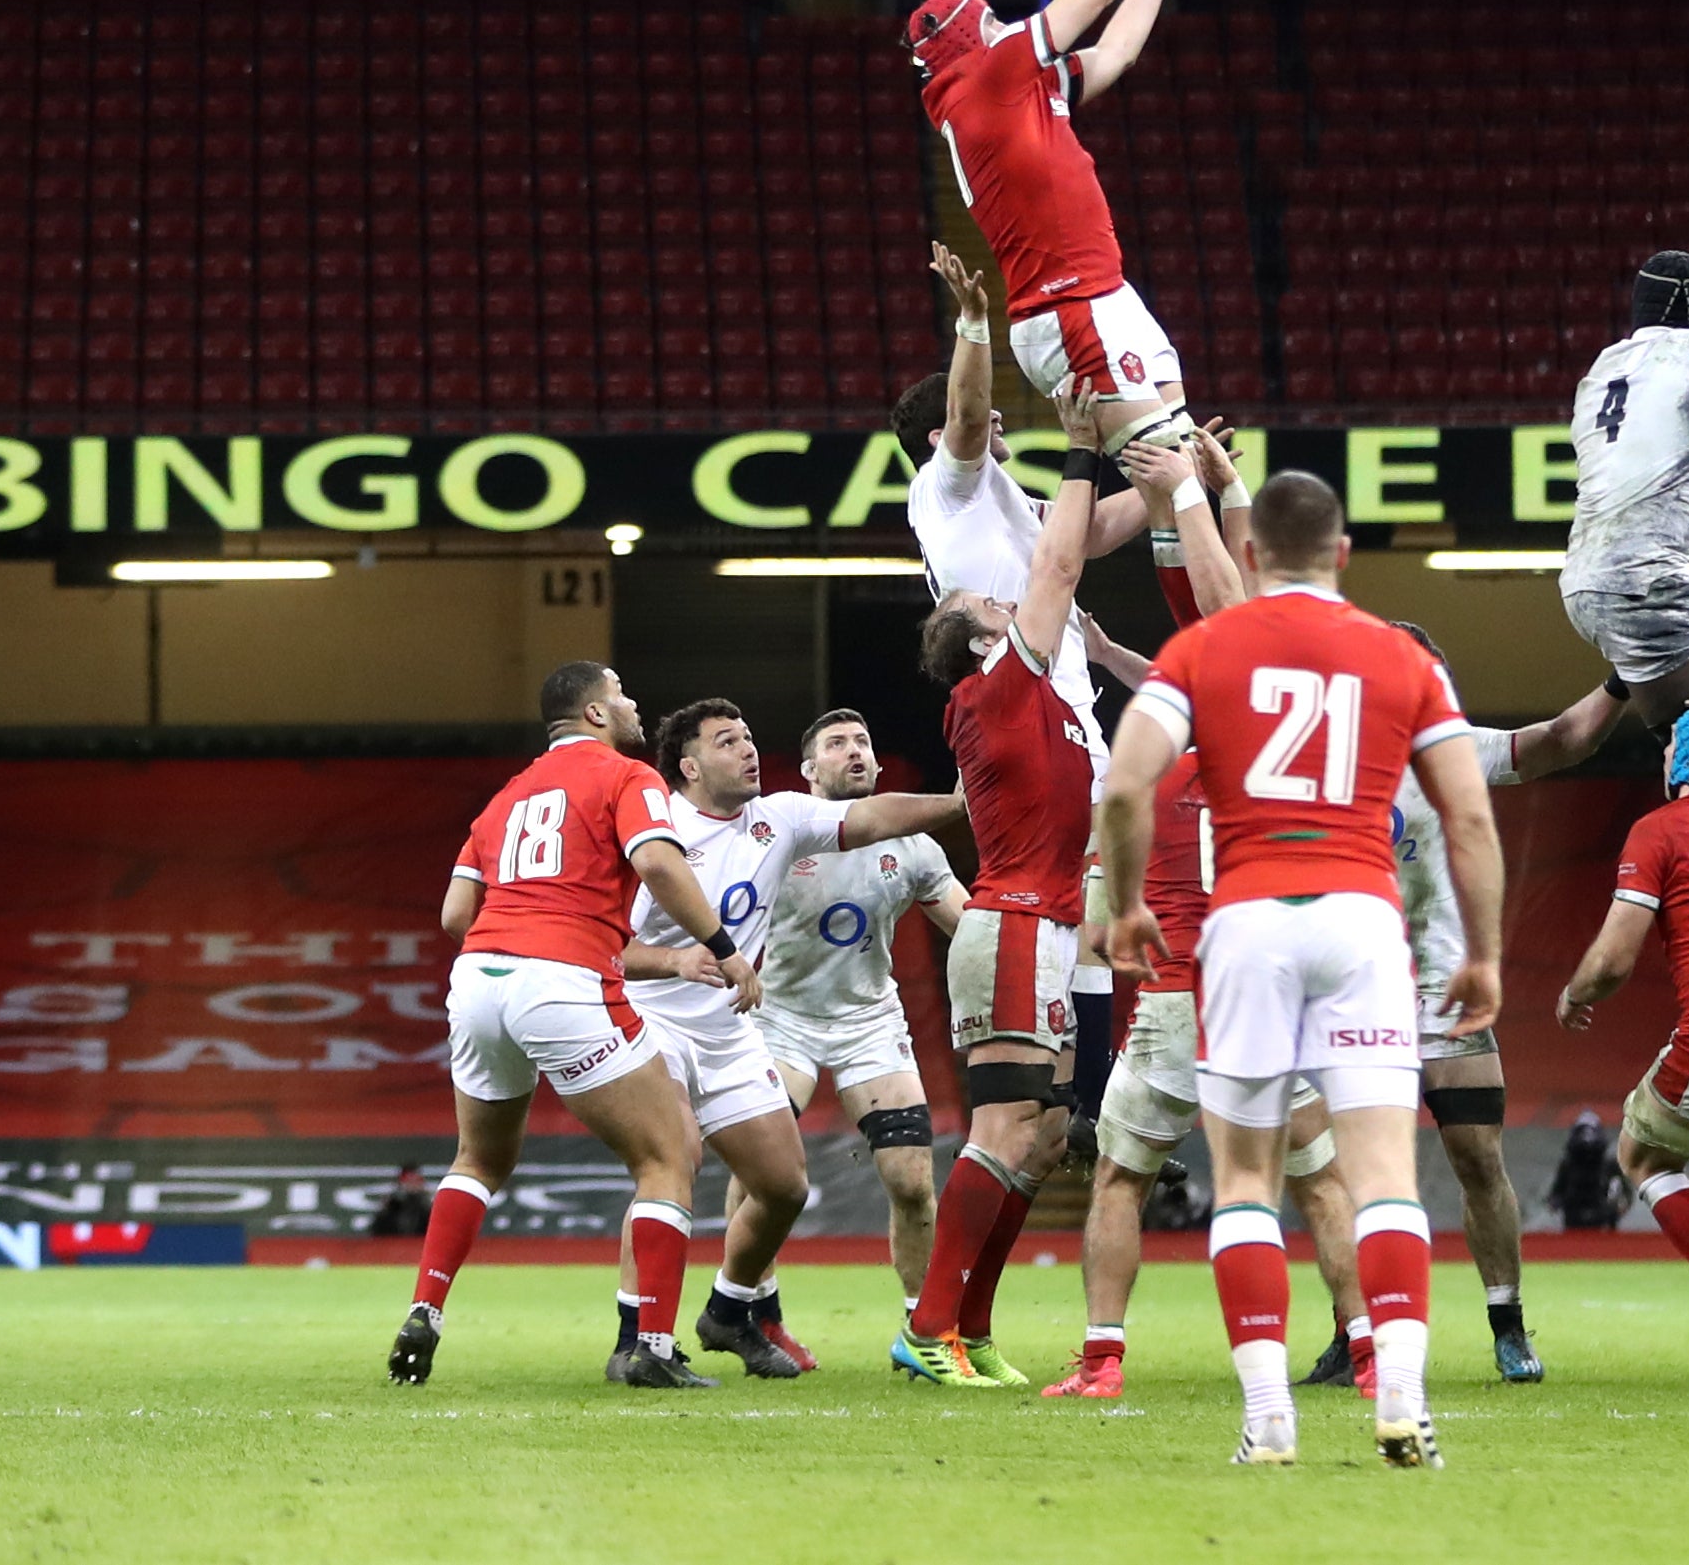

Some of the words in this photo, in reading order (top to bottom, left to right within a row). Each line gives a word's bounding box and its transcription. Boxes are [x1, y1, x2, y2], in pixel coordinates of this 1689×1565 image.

[1596, 378, 1629, 443] 4
[542, 570, 603, 607] L21
[1243, 666, 1363, 805] 21
[497, 788, 567, 884] 18
[28, 930, 448, 967] THI
[818, 901, 873, 954] O2
[207, 982, 449, 1023] OU
[559, 1037, 620, 1082] ISUZU
[1329, 1028, 1411, 1047] ISUZU
